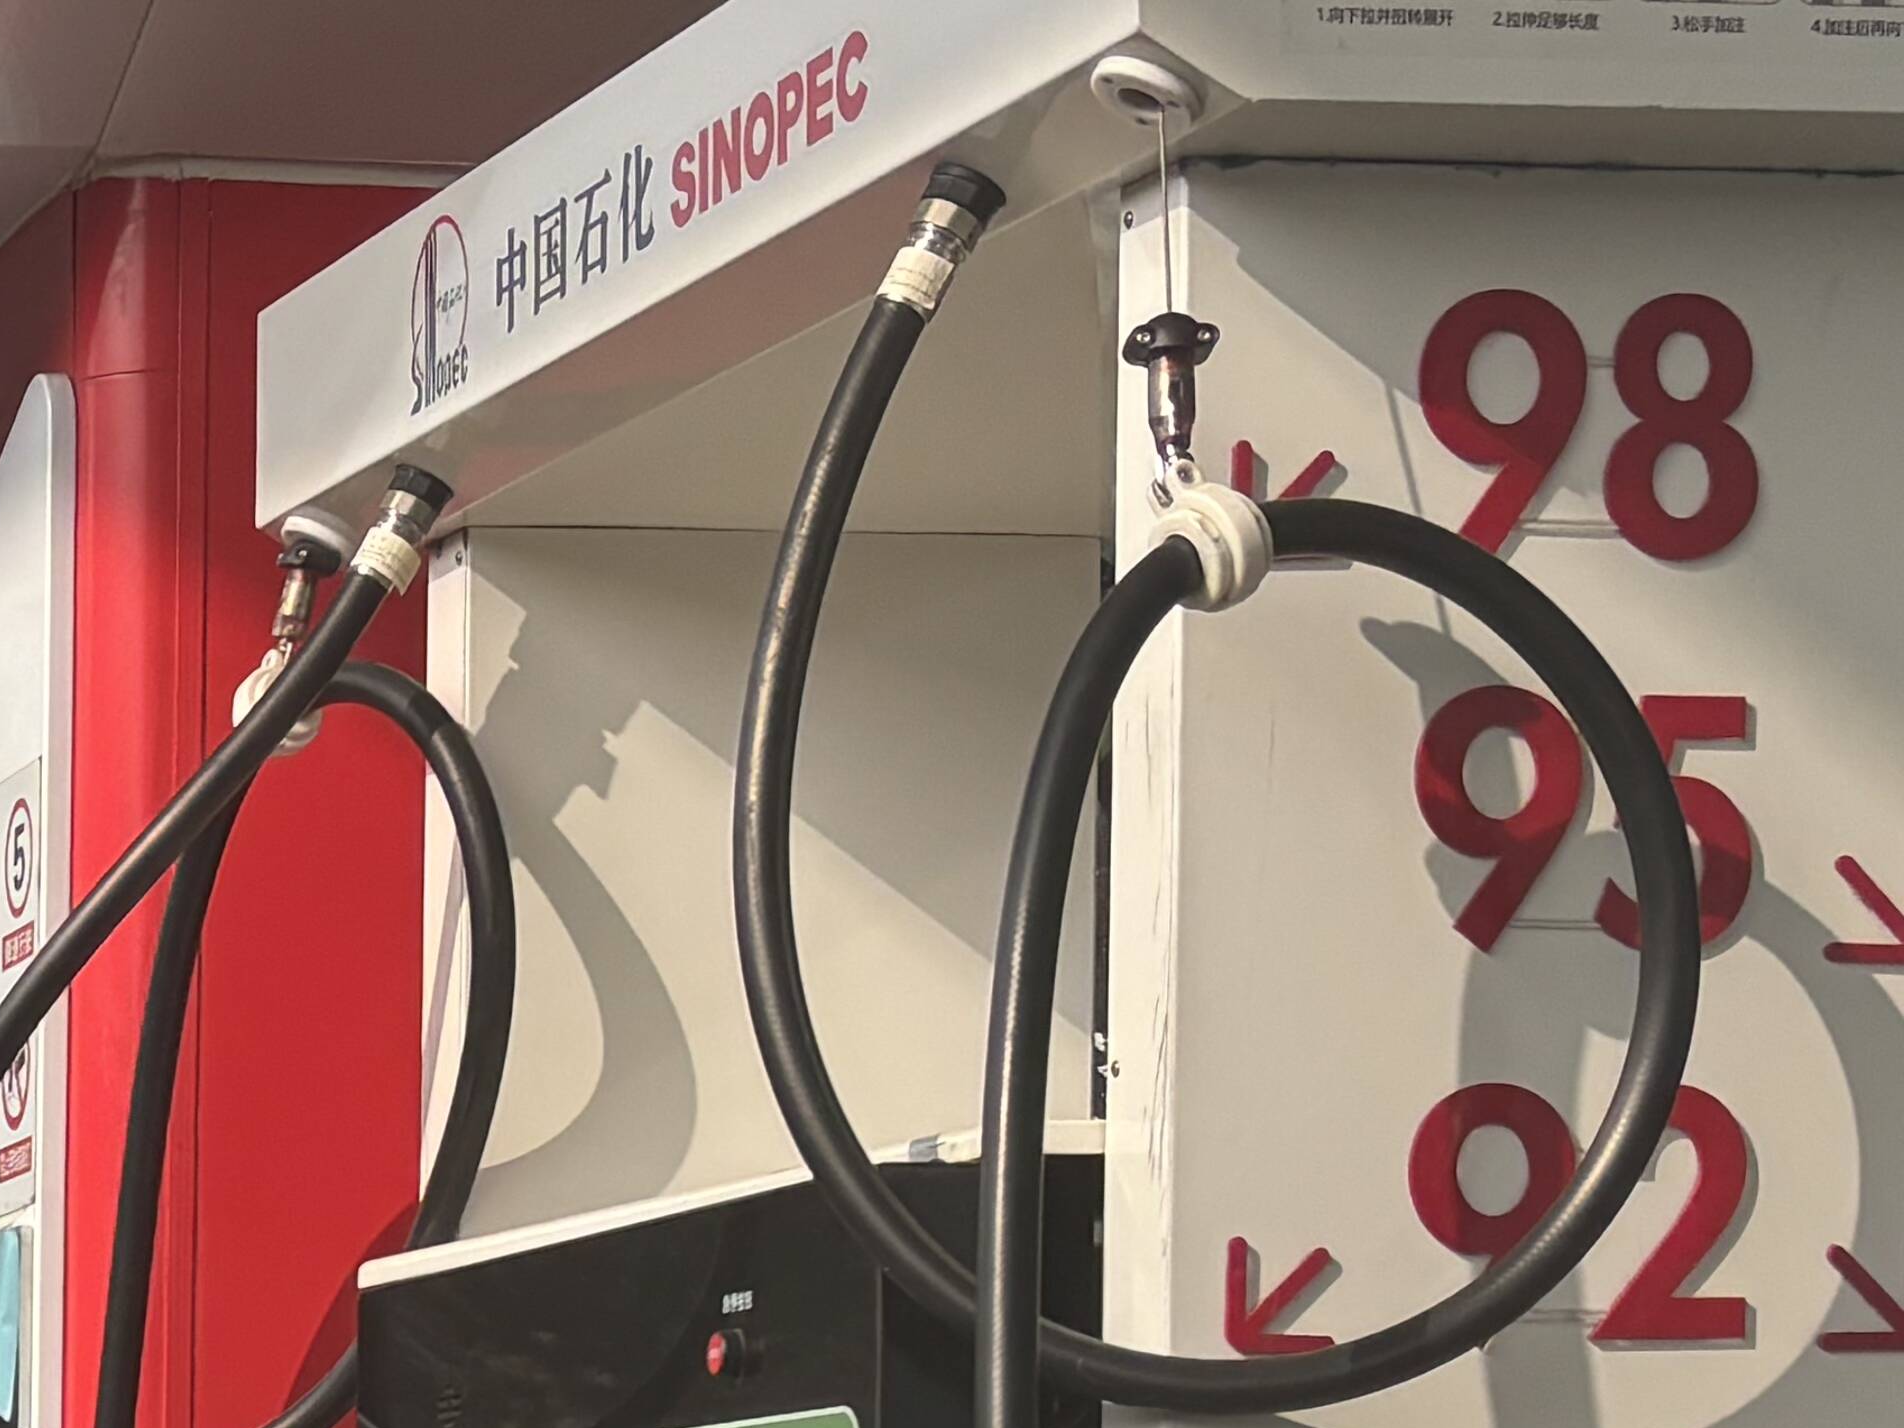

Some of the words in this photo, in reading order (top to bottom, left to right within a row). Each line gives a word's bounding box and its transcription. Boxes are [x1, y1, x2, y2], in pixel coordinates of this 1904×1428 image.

[495, 145, 655, 334] 中国石化
[671, 30, 869, 229] SINOPEC
[1418, 288, 1759, 561] 98
[12, 823, 26, 889] 5
[1415, 685, 1752, 953] 95
[1409, 1083, 1748, 1344] 92
